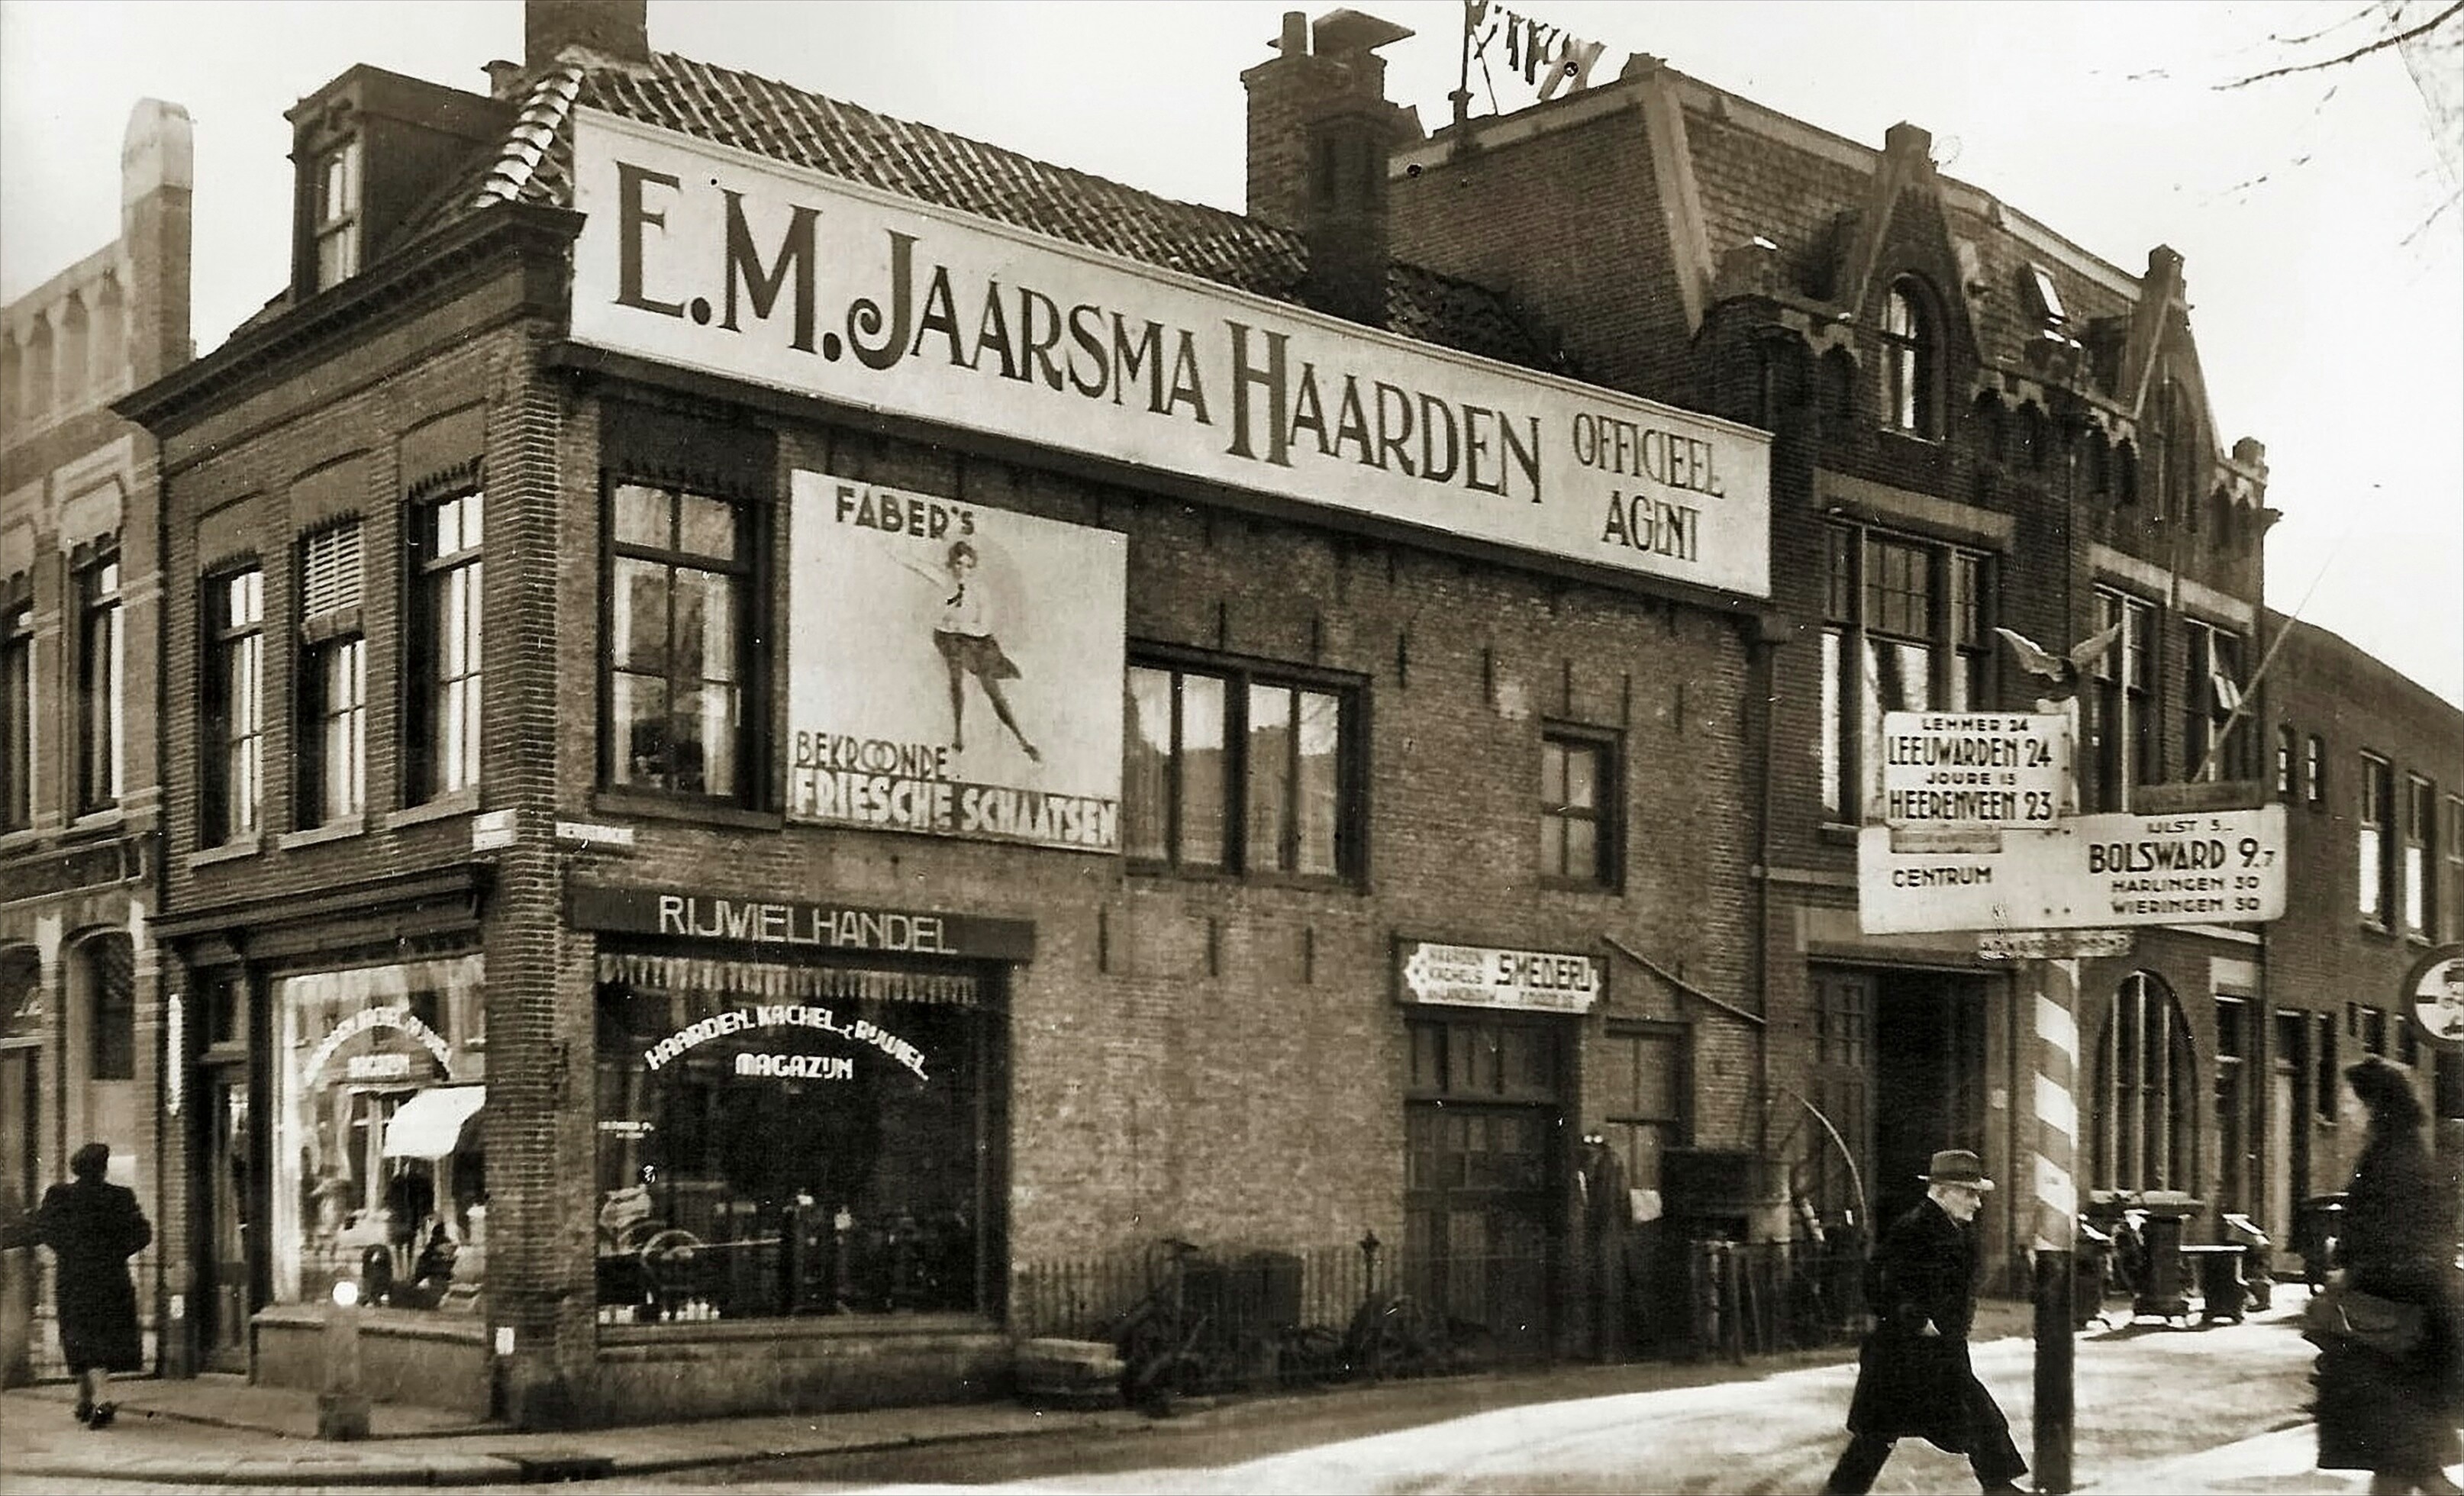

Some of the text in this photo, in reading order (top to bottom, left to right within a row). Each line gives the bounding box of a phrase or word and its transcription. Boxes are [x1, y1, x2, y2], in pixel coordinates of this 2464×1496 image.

[1224, 318, 1542, 504] HAARDEN
[1573, 412, 1726, 499] OFFICIEEL
[836, 485, 975, 539] FABER'S
[1601, 490, 1701, 563] AGENT
[1922, 717, 2000, 732] LEMMER
[796, 730, 947, 780] BEKROONDE
[1888, 736, 2053, 768] LEEUWARDEN 24
[1926, 772, 1991, 785] JOURE
[795, 767, 1118, 844] FRIESCHE SCHAATSEN
[1888, 789, 2053, 821] HEERENVEEN 23
[2088, 839, 2226, 874] BOLSWARD
[1891, 866, 1992, 888] CENTRUM
[2111, 877, 2225, 893] HARLINGEN
[2111, 898, 2224, 914] WIERINGEN
[658, 894, 958, 953] RIJWIELHANDEL
[735, 1053, 853, 1080] MAGAZIJN
